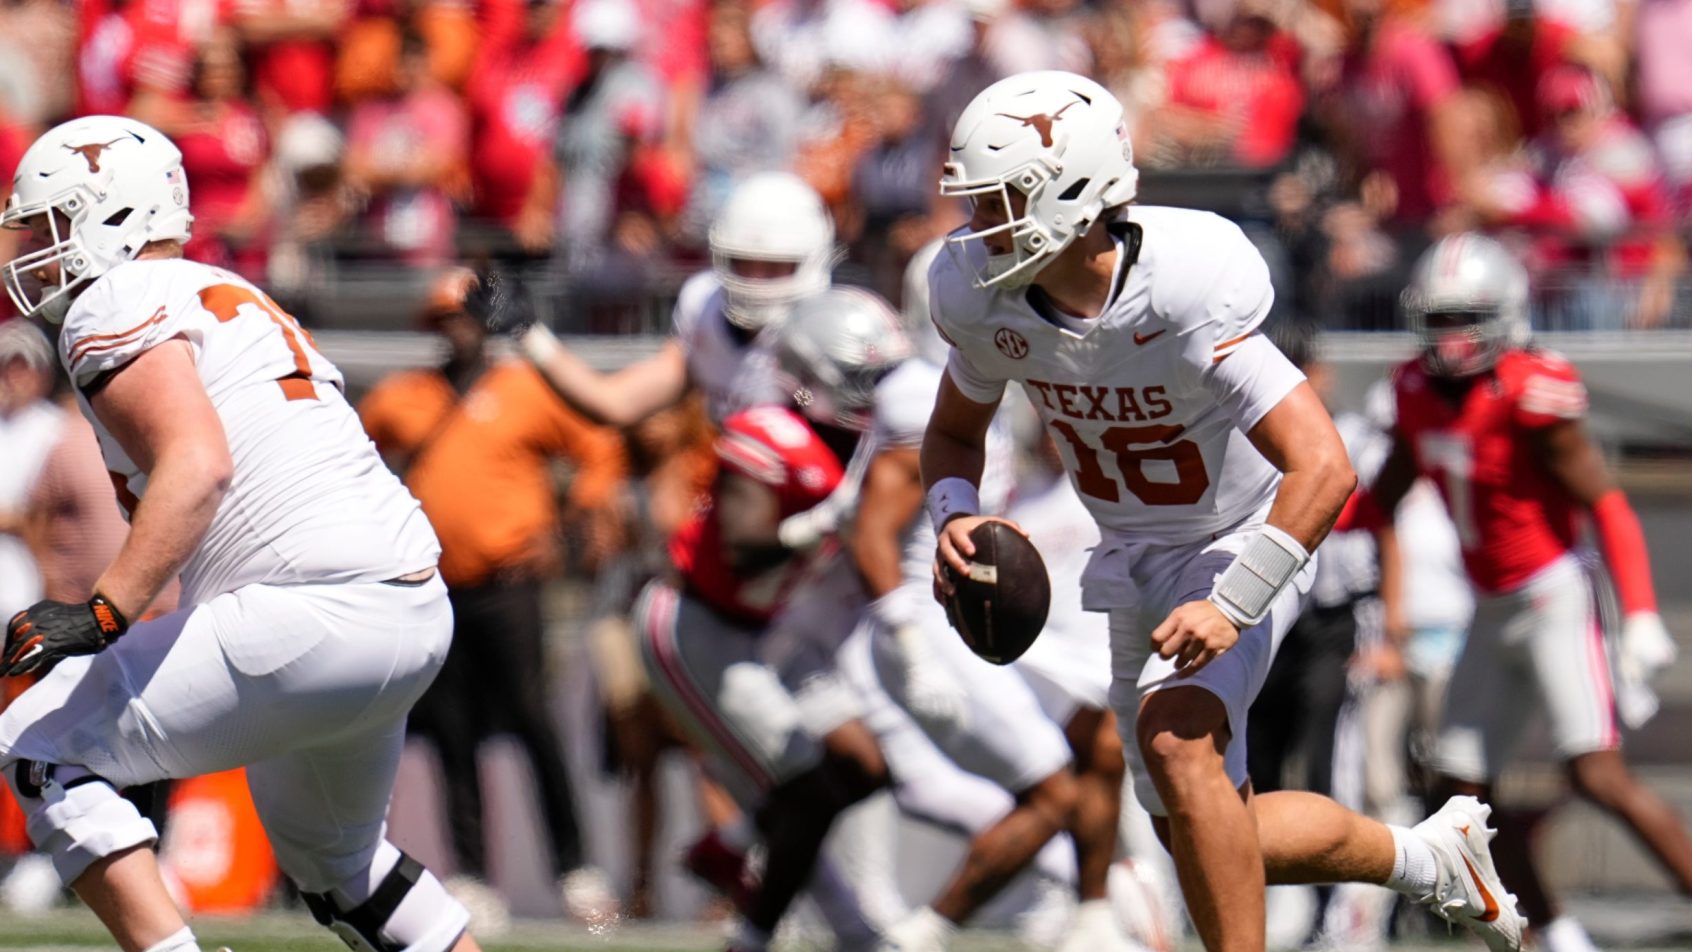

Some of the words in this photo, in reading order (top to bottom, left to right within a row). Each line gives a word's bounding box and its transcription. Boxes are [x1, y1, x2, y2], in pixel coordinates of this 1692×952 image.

[1026, 378, 1173, 422] TEXAS
[1050, 418, 1210, 506] 16
[93, 603, 119, 633] NIKE
